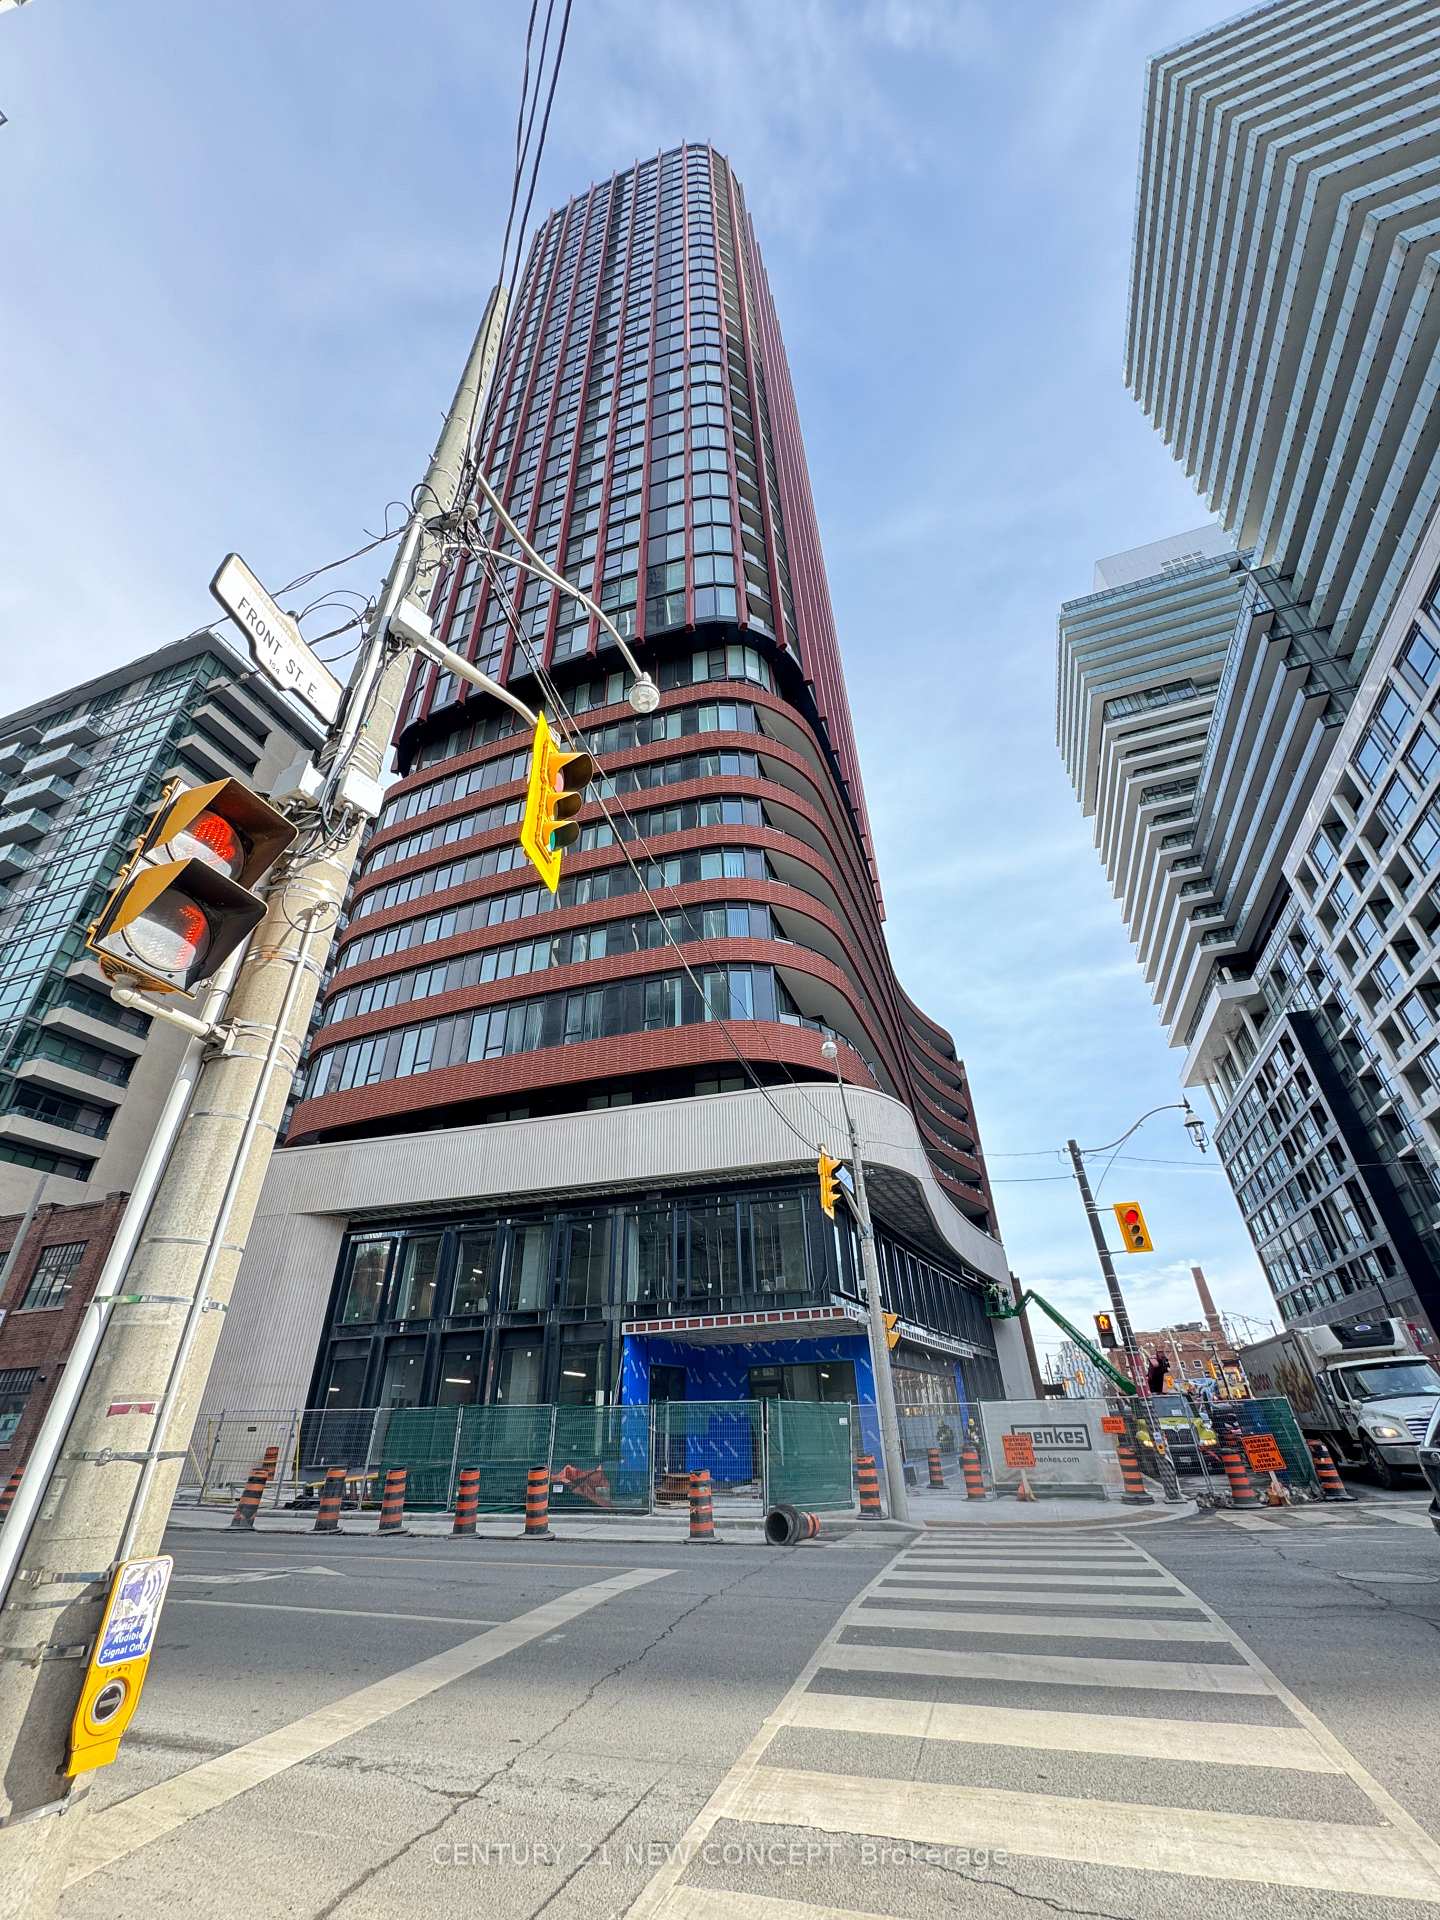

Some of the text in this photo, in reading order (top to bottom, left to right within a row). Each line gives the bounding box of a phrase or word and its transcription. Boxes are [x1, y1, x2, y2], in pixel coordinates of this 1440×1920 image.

[237, 596, 318, 703] FRONT ST. E.
[102, 1645, 128, 1659] Signal
